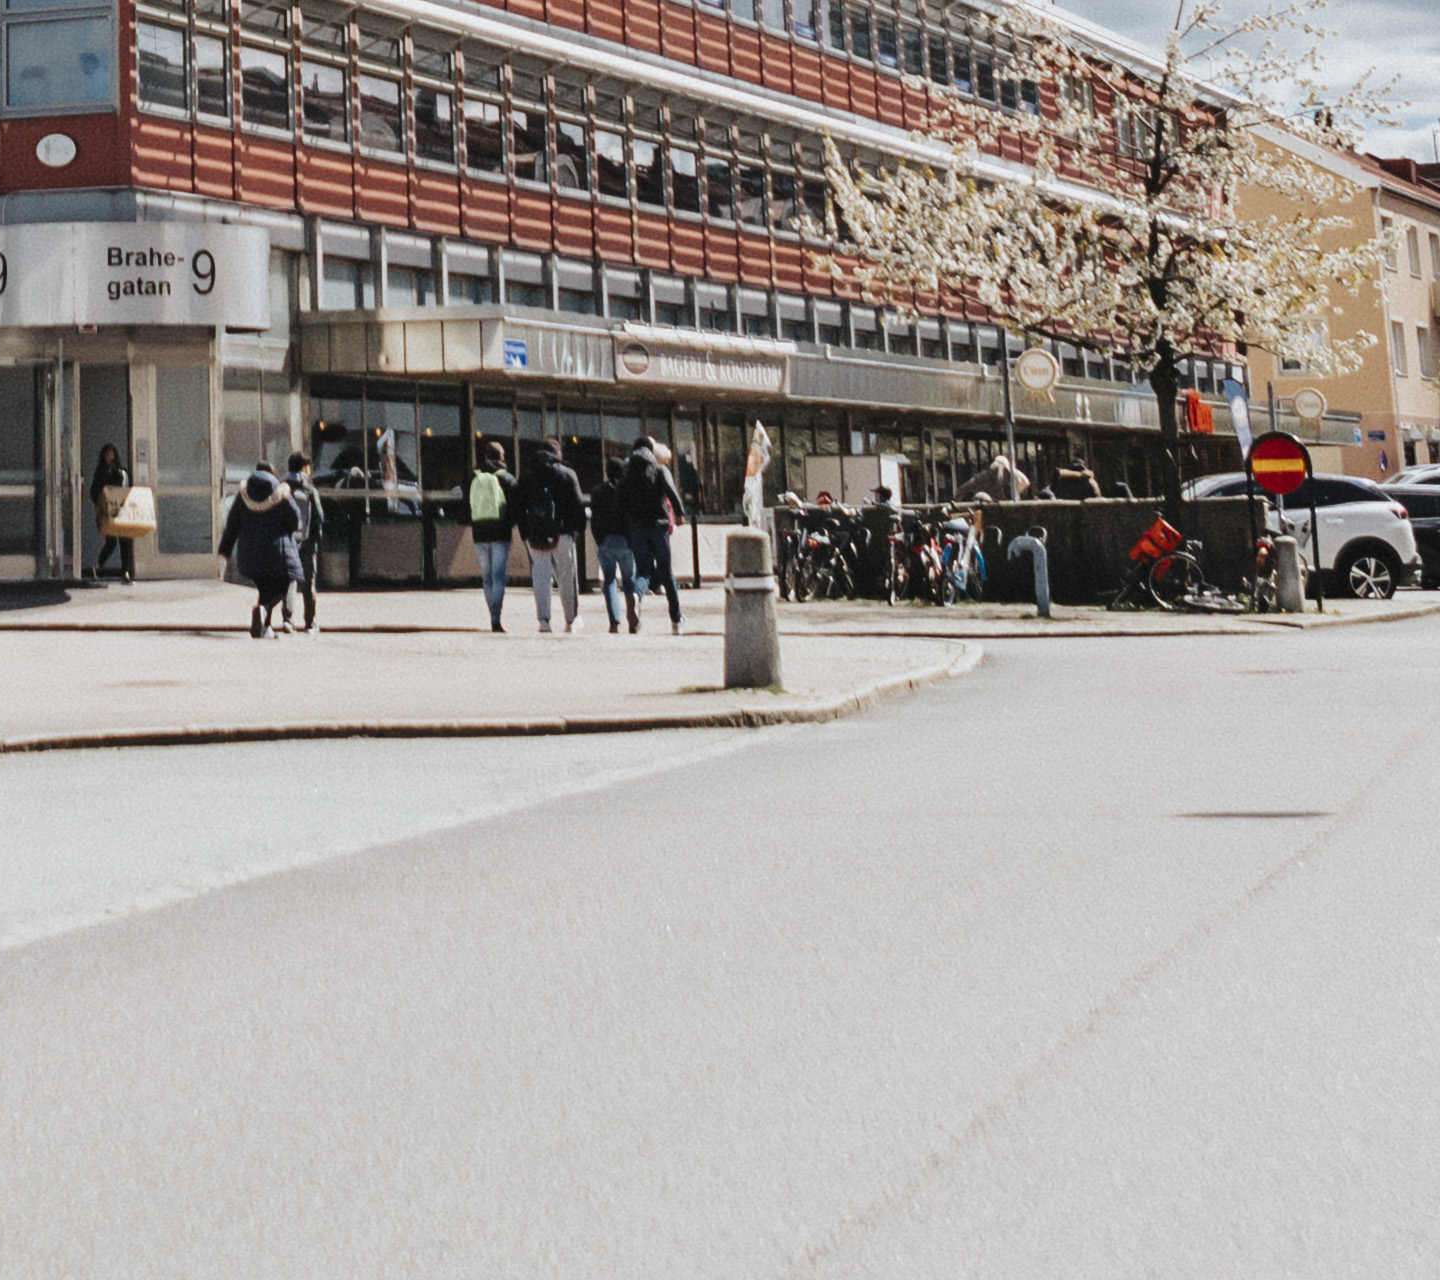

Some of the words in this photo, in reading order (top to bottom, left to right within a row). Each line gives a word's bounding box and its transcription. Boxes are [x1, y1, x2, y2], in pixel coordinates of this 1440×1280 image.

[107, 246, 184, 267] Brahe-
[191, 248, 217, 295] 9
[107, 276, 172, 301] gatan
[660, 353, 702, 379] BAGERI
[705, 349, 717, 381] &
